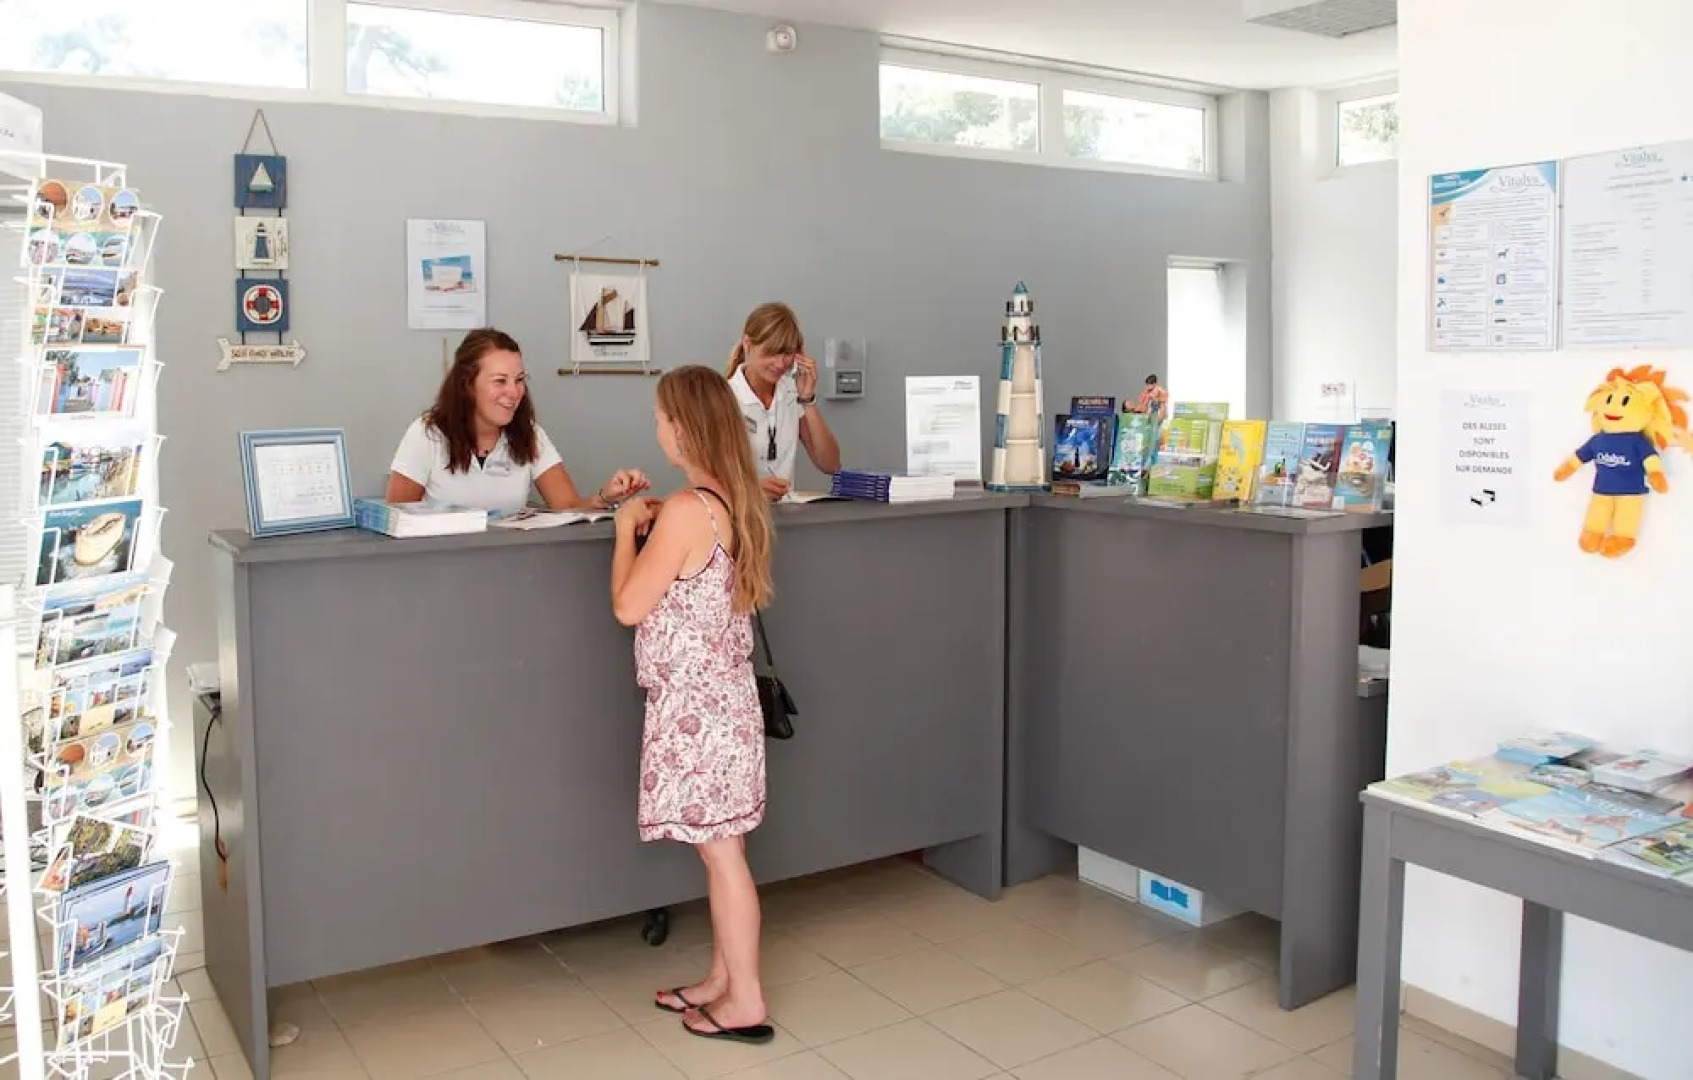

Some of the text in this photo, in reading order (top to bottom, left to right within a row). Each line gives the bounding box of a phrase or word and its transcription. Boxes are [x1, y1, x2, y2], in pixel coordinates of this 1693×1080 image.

[1462, 422, 1477, 431] DES
[1473, 437, 1496, 445] SONT
[1459, 449, 1510, 459] DISPONIBLES
[1472, 465, 1513, 475] DEMANDE
